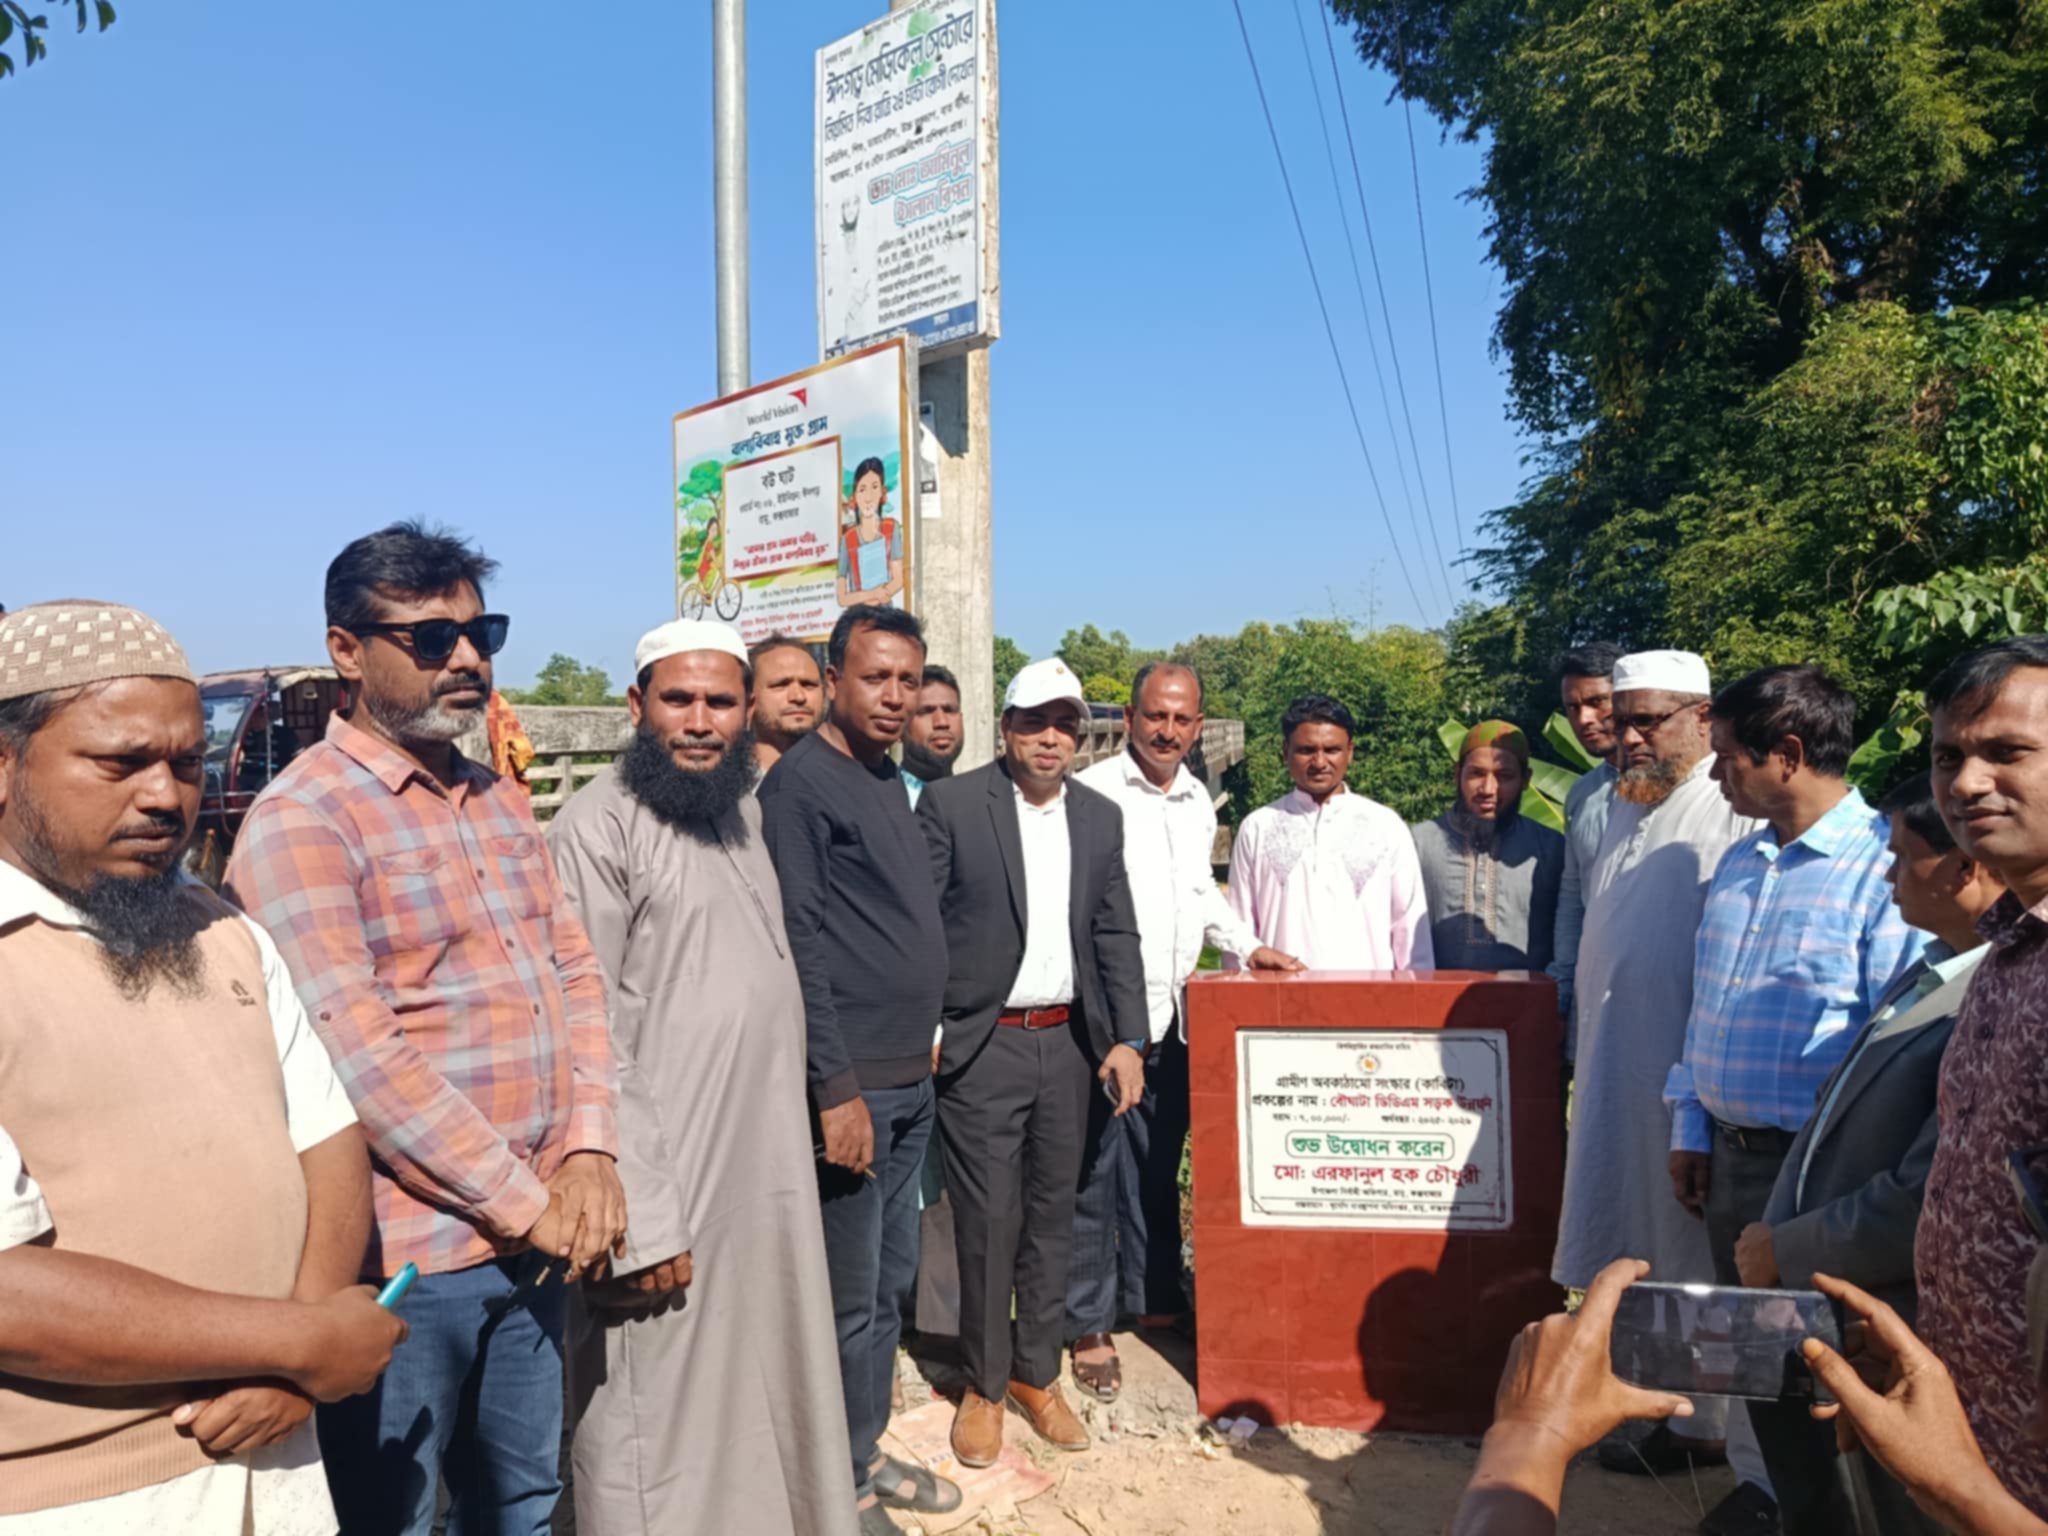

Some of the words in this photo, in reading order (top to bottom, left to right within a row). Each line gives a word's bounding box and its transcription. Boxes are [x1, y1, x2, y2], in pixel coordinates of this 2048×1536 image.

[866, 37, 924, 87] মেডিকেল
[746, 407, 772, 427] World
[772, 402, 799, 419] Vision
[784, 423, 805, 448] মুক্ত
[807, 415, 829, 438] গ্রাম
[1275, 1073, 1308, 1089] গ্রামীণ
[1311, 1073, 1371, 1090] অবকাঠামো
[1374, 1077, 1411, 1090] সংস্কার
[1296, 1094, 1319, 1107] নাম
[1422, 1096, 1454, 1112] সড়ক
[1291, 1137, 1322, 1153] শুভ
[1326, 1133, 1391, 1156] উদ্বোধন
[1395, 1140, 1446, 1156] করেন
[1311, 1165, 1385, 1187] এরফানুল
[1390, 1167, 1420, 1184] হক
[1425, 1163, 1482, 1189] চৌধুরী
